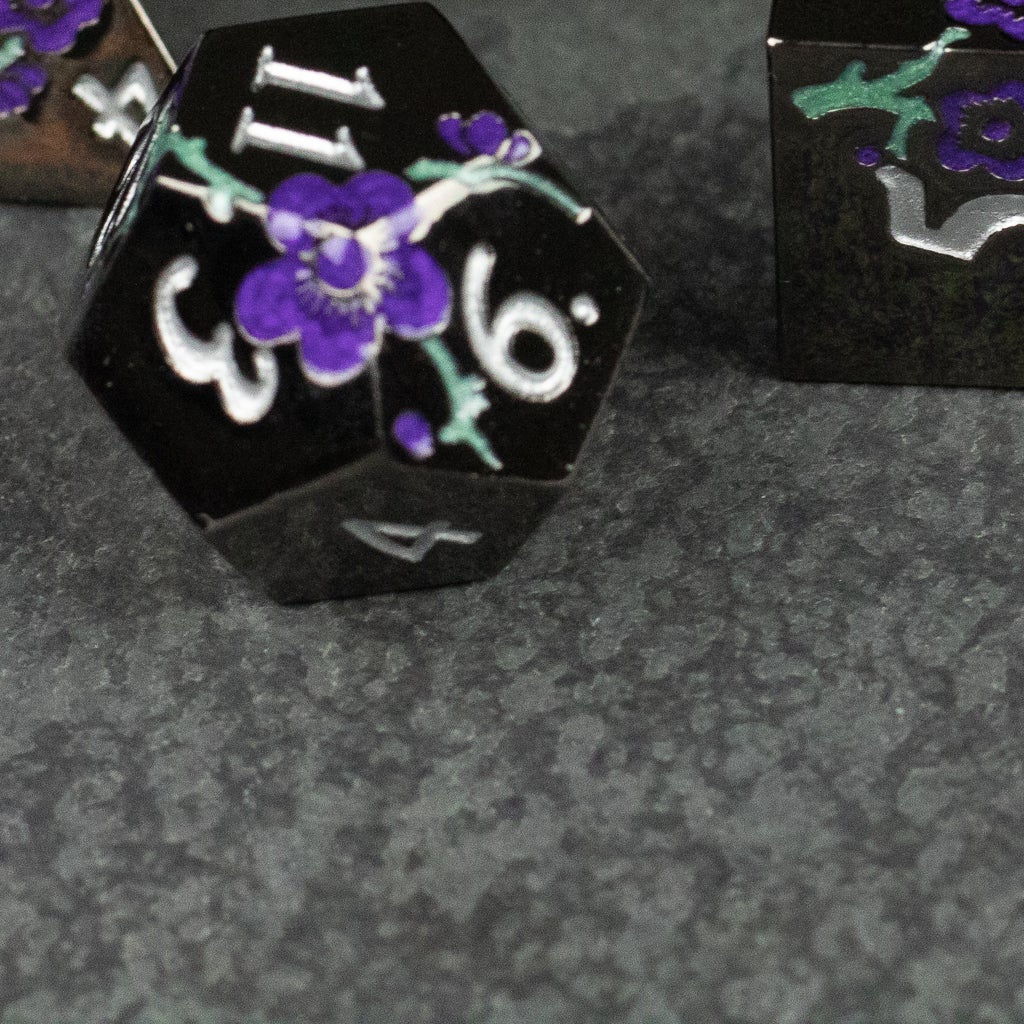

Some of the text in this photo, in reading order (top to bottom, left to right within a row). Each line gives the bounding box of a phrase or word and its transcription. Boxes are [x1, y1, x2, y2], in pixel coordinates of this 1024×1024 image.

[231, 45, 385, 170] 11
[152, 255, 279, 425] 3
[340, 519, 485, 563] 4
